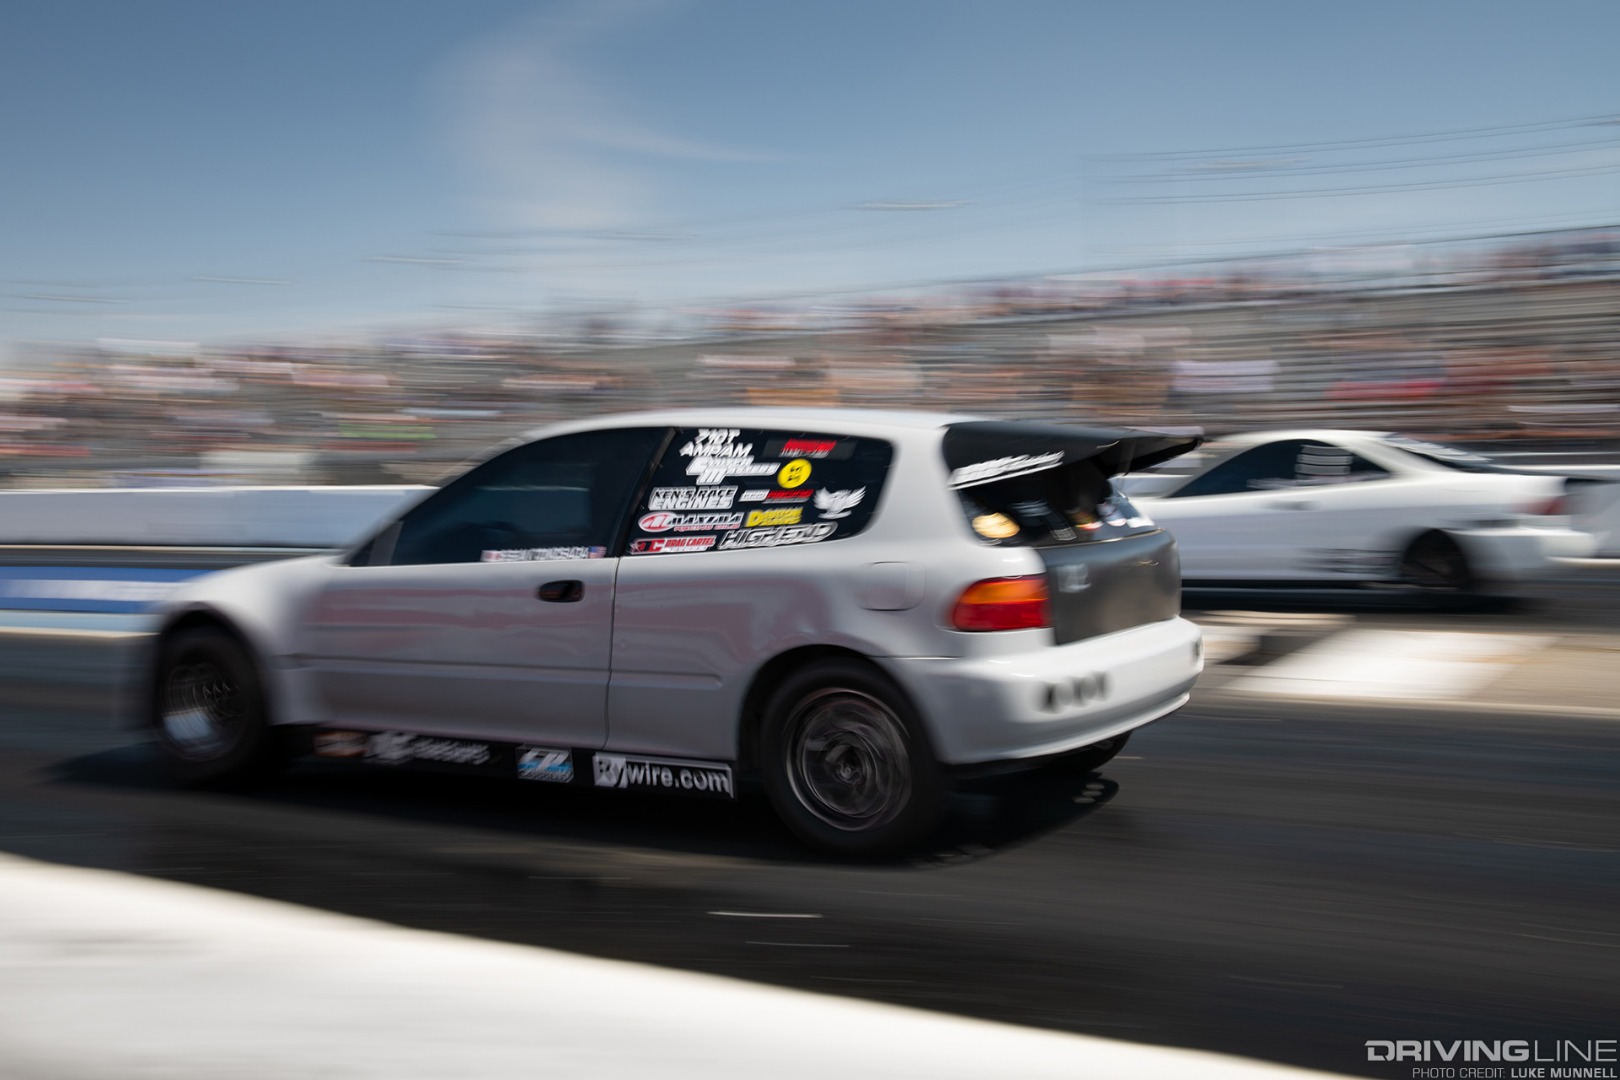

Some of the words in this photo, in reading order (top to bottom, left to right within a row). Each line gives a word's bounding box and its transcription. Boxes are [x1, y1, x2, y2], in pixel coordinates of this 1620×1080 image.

[698, 488, 736, 499] RACE
[651, 498, 731, 510] ENGINES
[665, 538, 686, 548] DRAG
[686, 536, 715, 547] CARTEL
